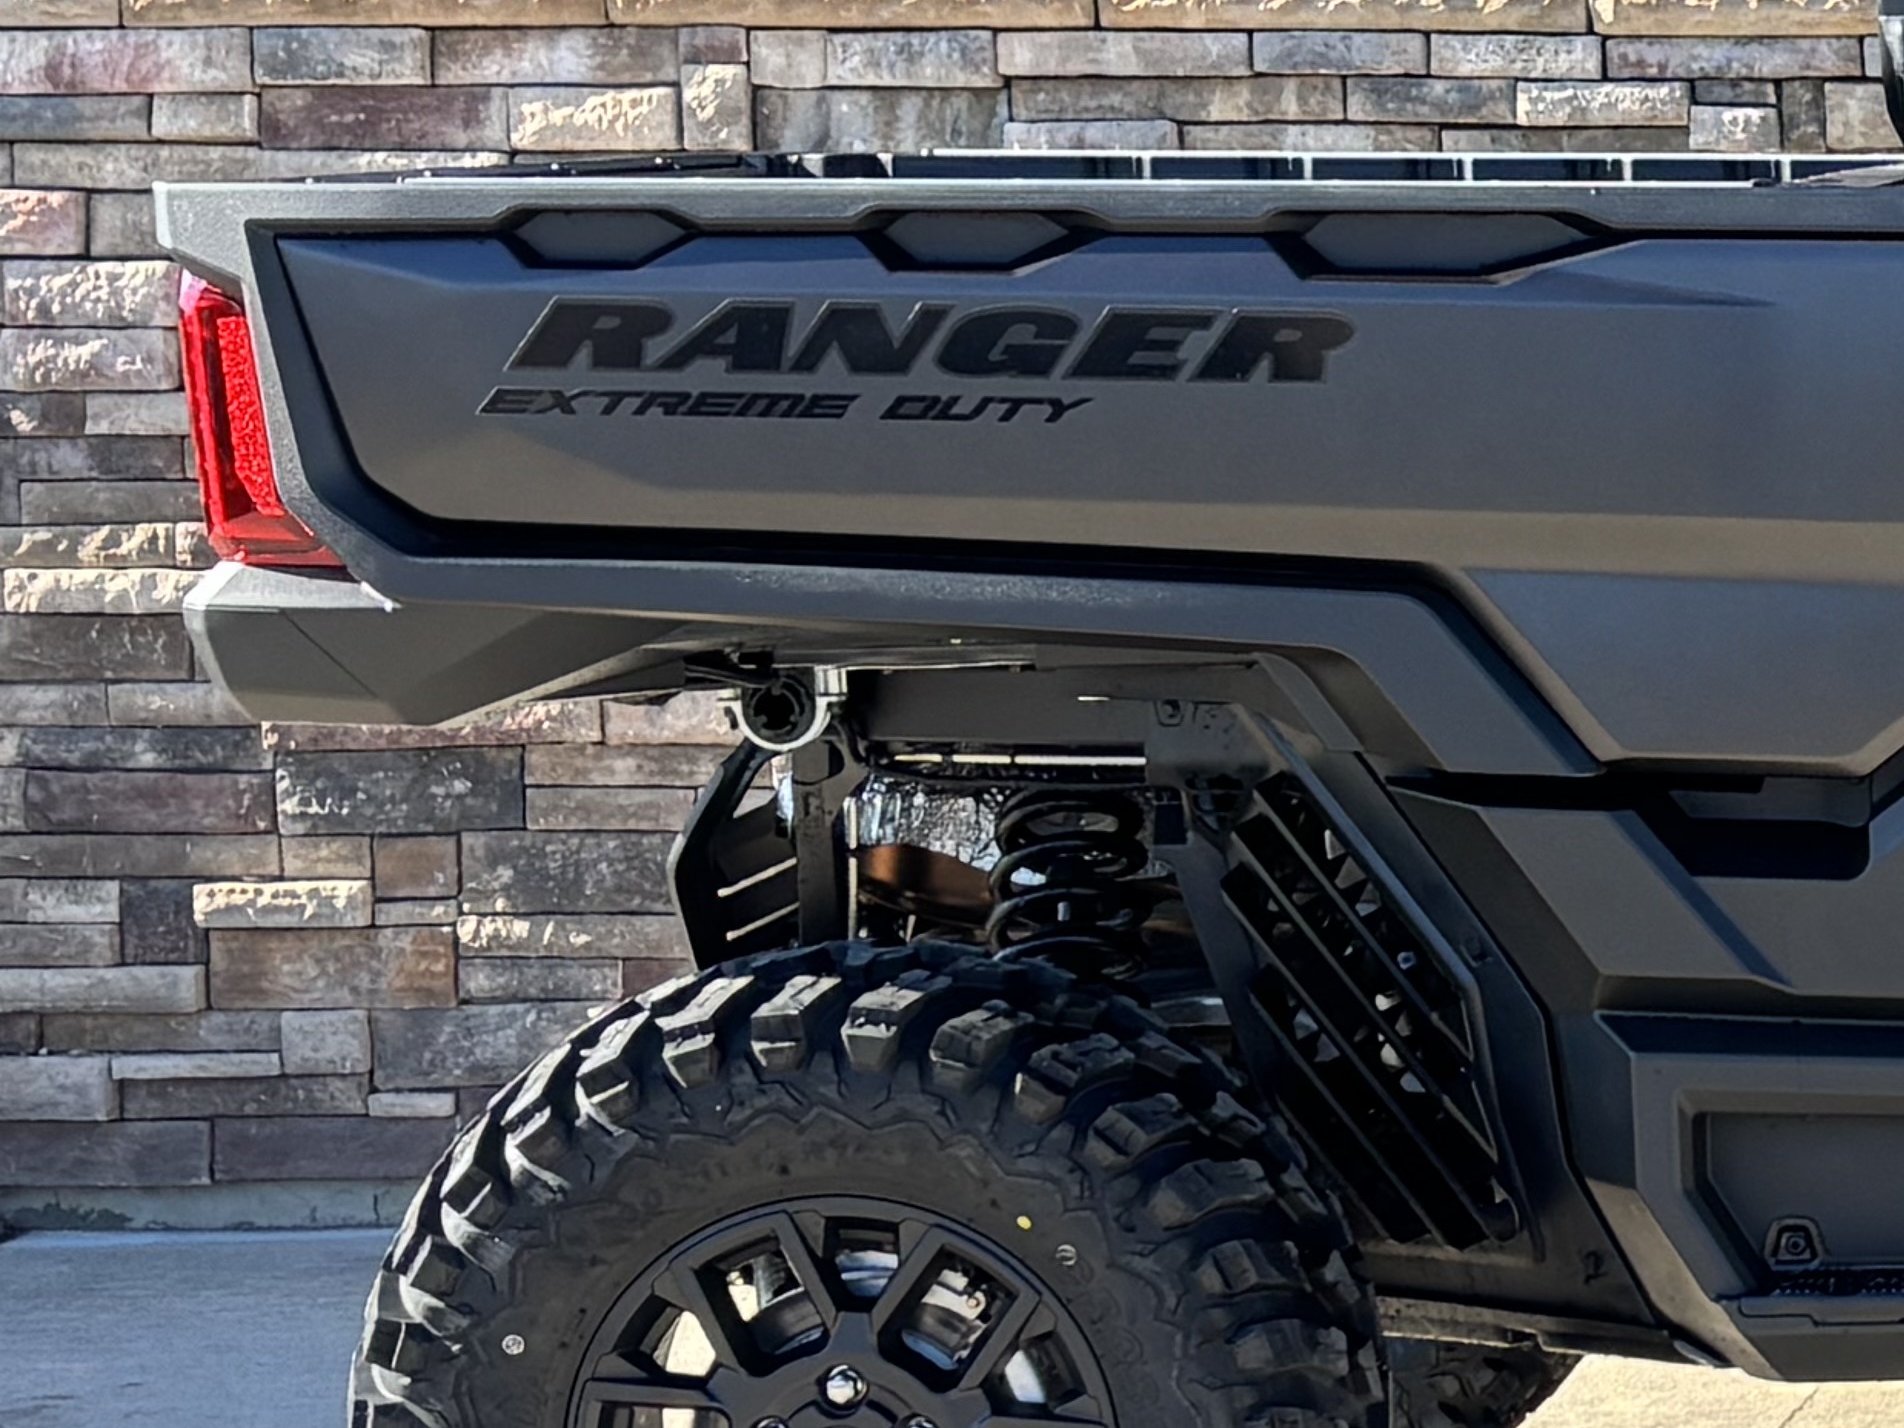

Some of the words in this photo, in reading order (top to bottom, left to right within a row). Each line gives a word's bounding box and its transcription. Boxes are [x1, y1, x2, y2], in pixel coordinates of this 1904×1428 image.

[502, 295, 1356, 384] RANGER
[475, 385, 859, 421] EXTREME
[878, 393, 1096, 425] DUTY
